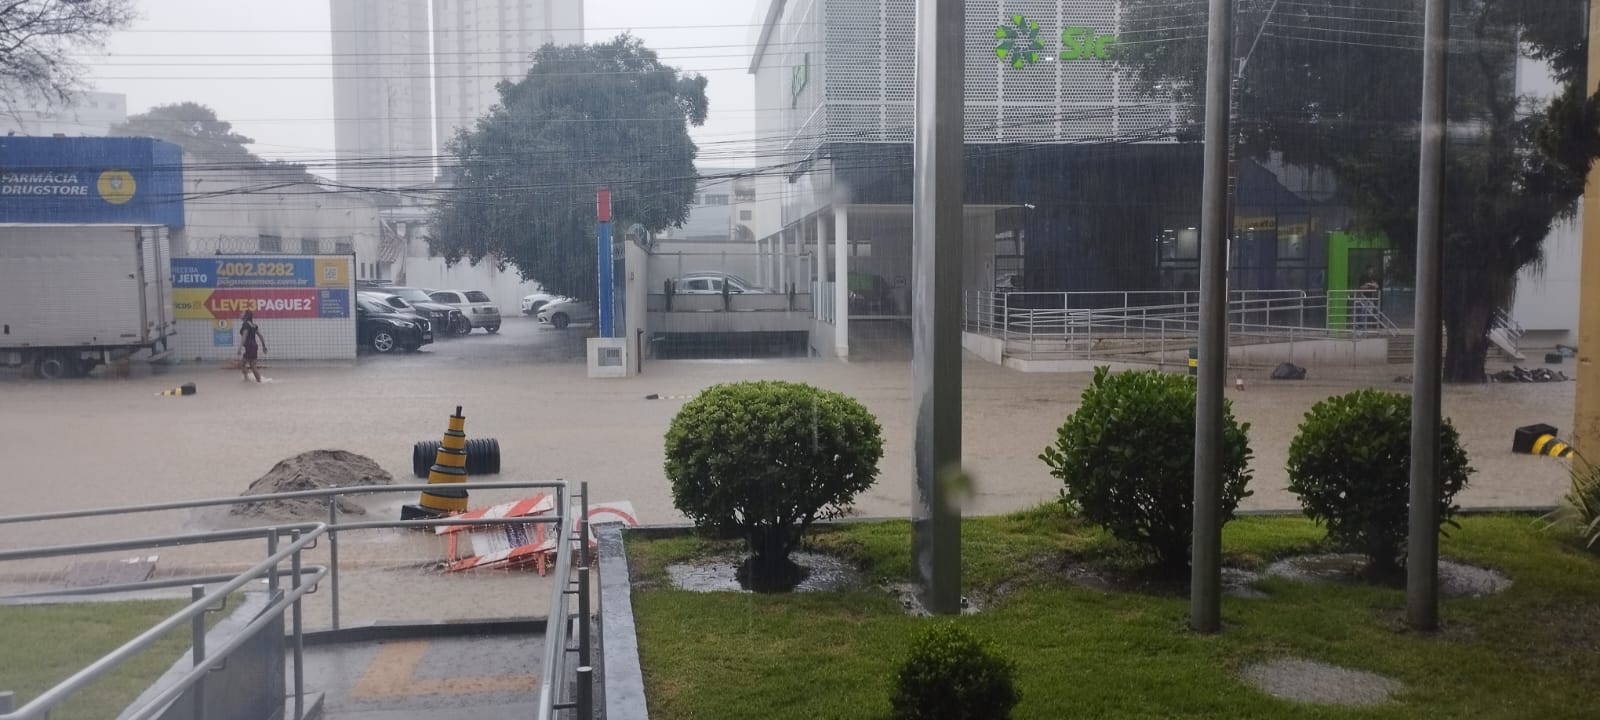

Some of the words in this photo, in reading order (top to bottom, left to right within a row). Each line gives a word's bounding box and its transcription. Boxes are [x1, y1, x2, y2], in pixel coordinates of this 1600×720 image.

[2, 170, 78, 183] FARMÁCIA
[2, 185, 89, 195] DRUGSTORE
[216, 261, 294, 276] 4002.8282
[178, 274, 208, 283] JEITO
